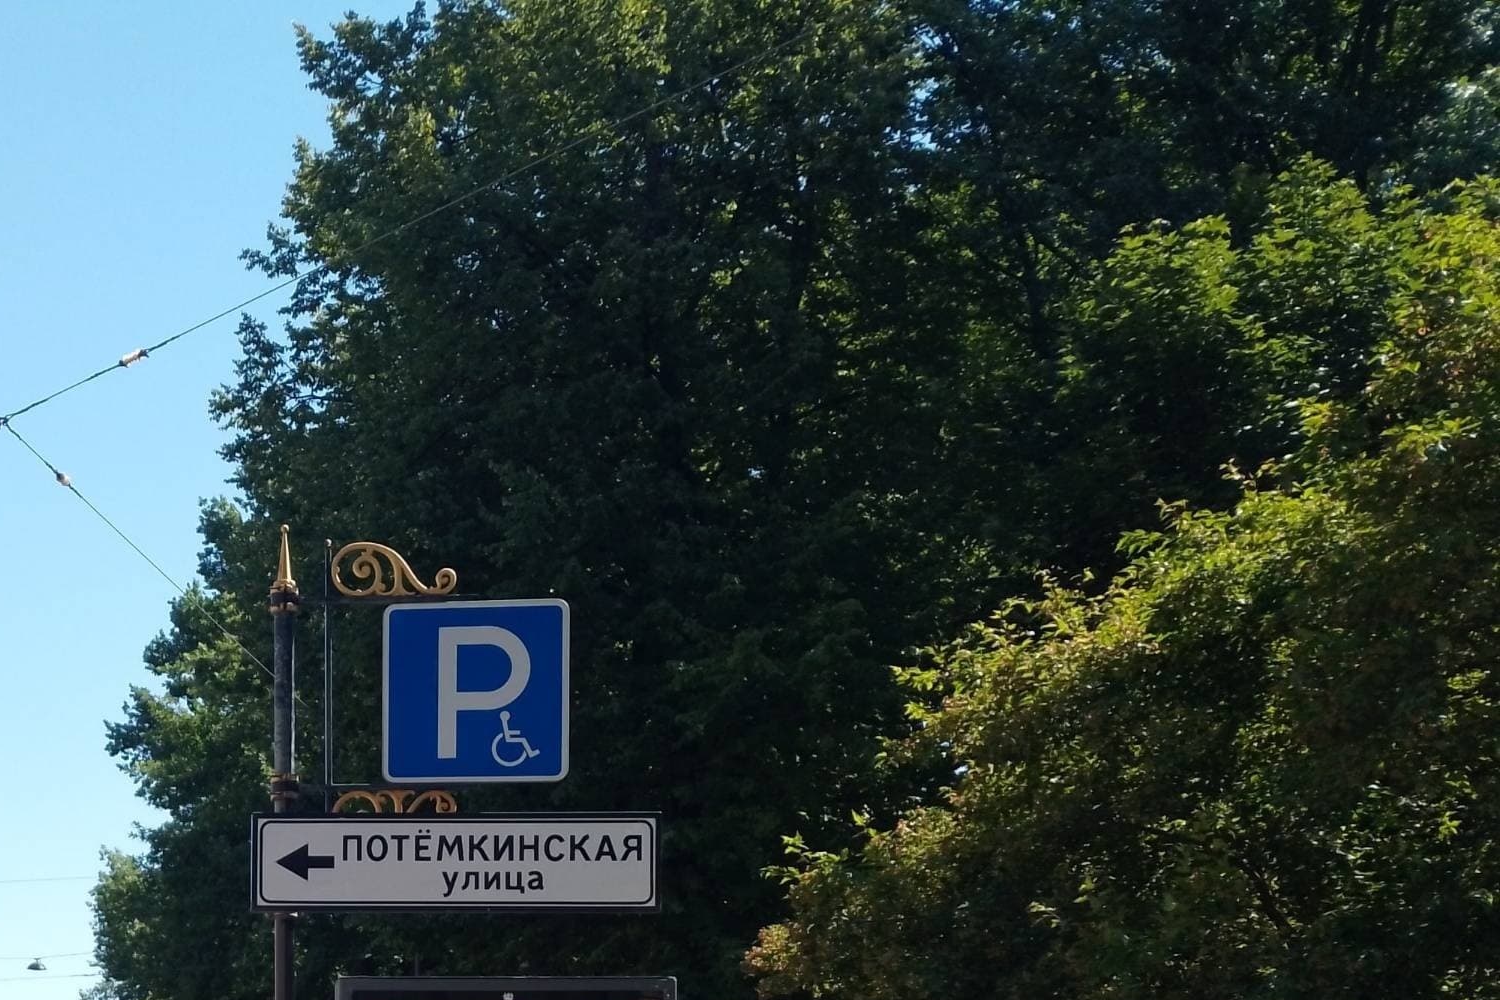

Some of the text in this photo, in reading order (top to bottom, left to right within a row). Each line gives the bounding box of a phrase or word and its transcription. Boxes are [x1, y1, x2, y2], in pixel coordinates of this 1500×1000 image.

[437, 625, 531, 759] P
[341, 828, 643, 863] ПОТЁМКИНСКАЯ
[441, 869, 545, 897] улица
